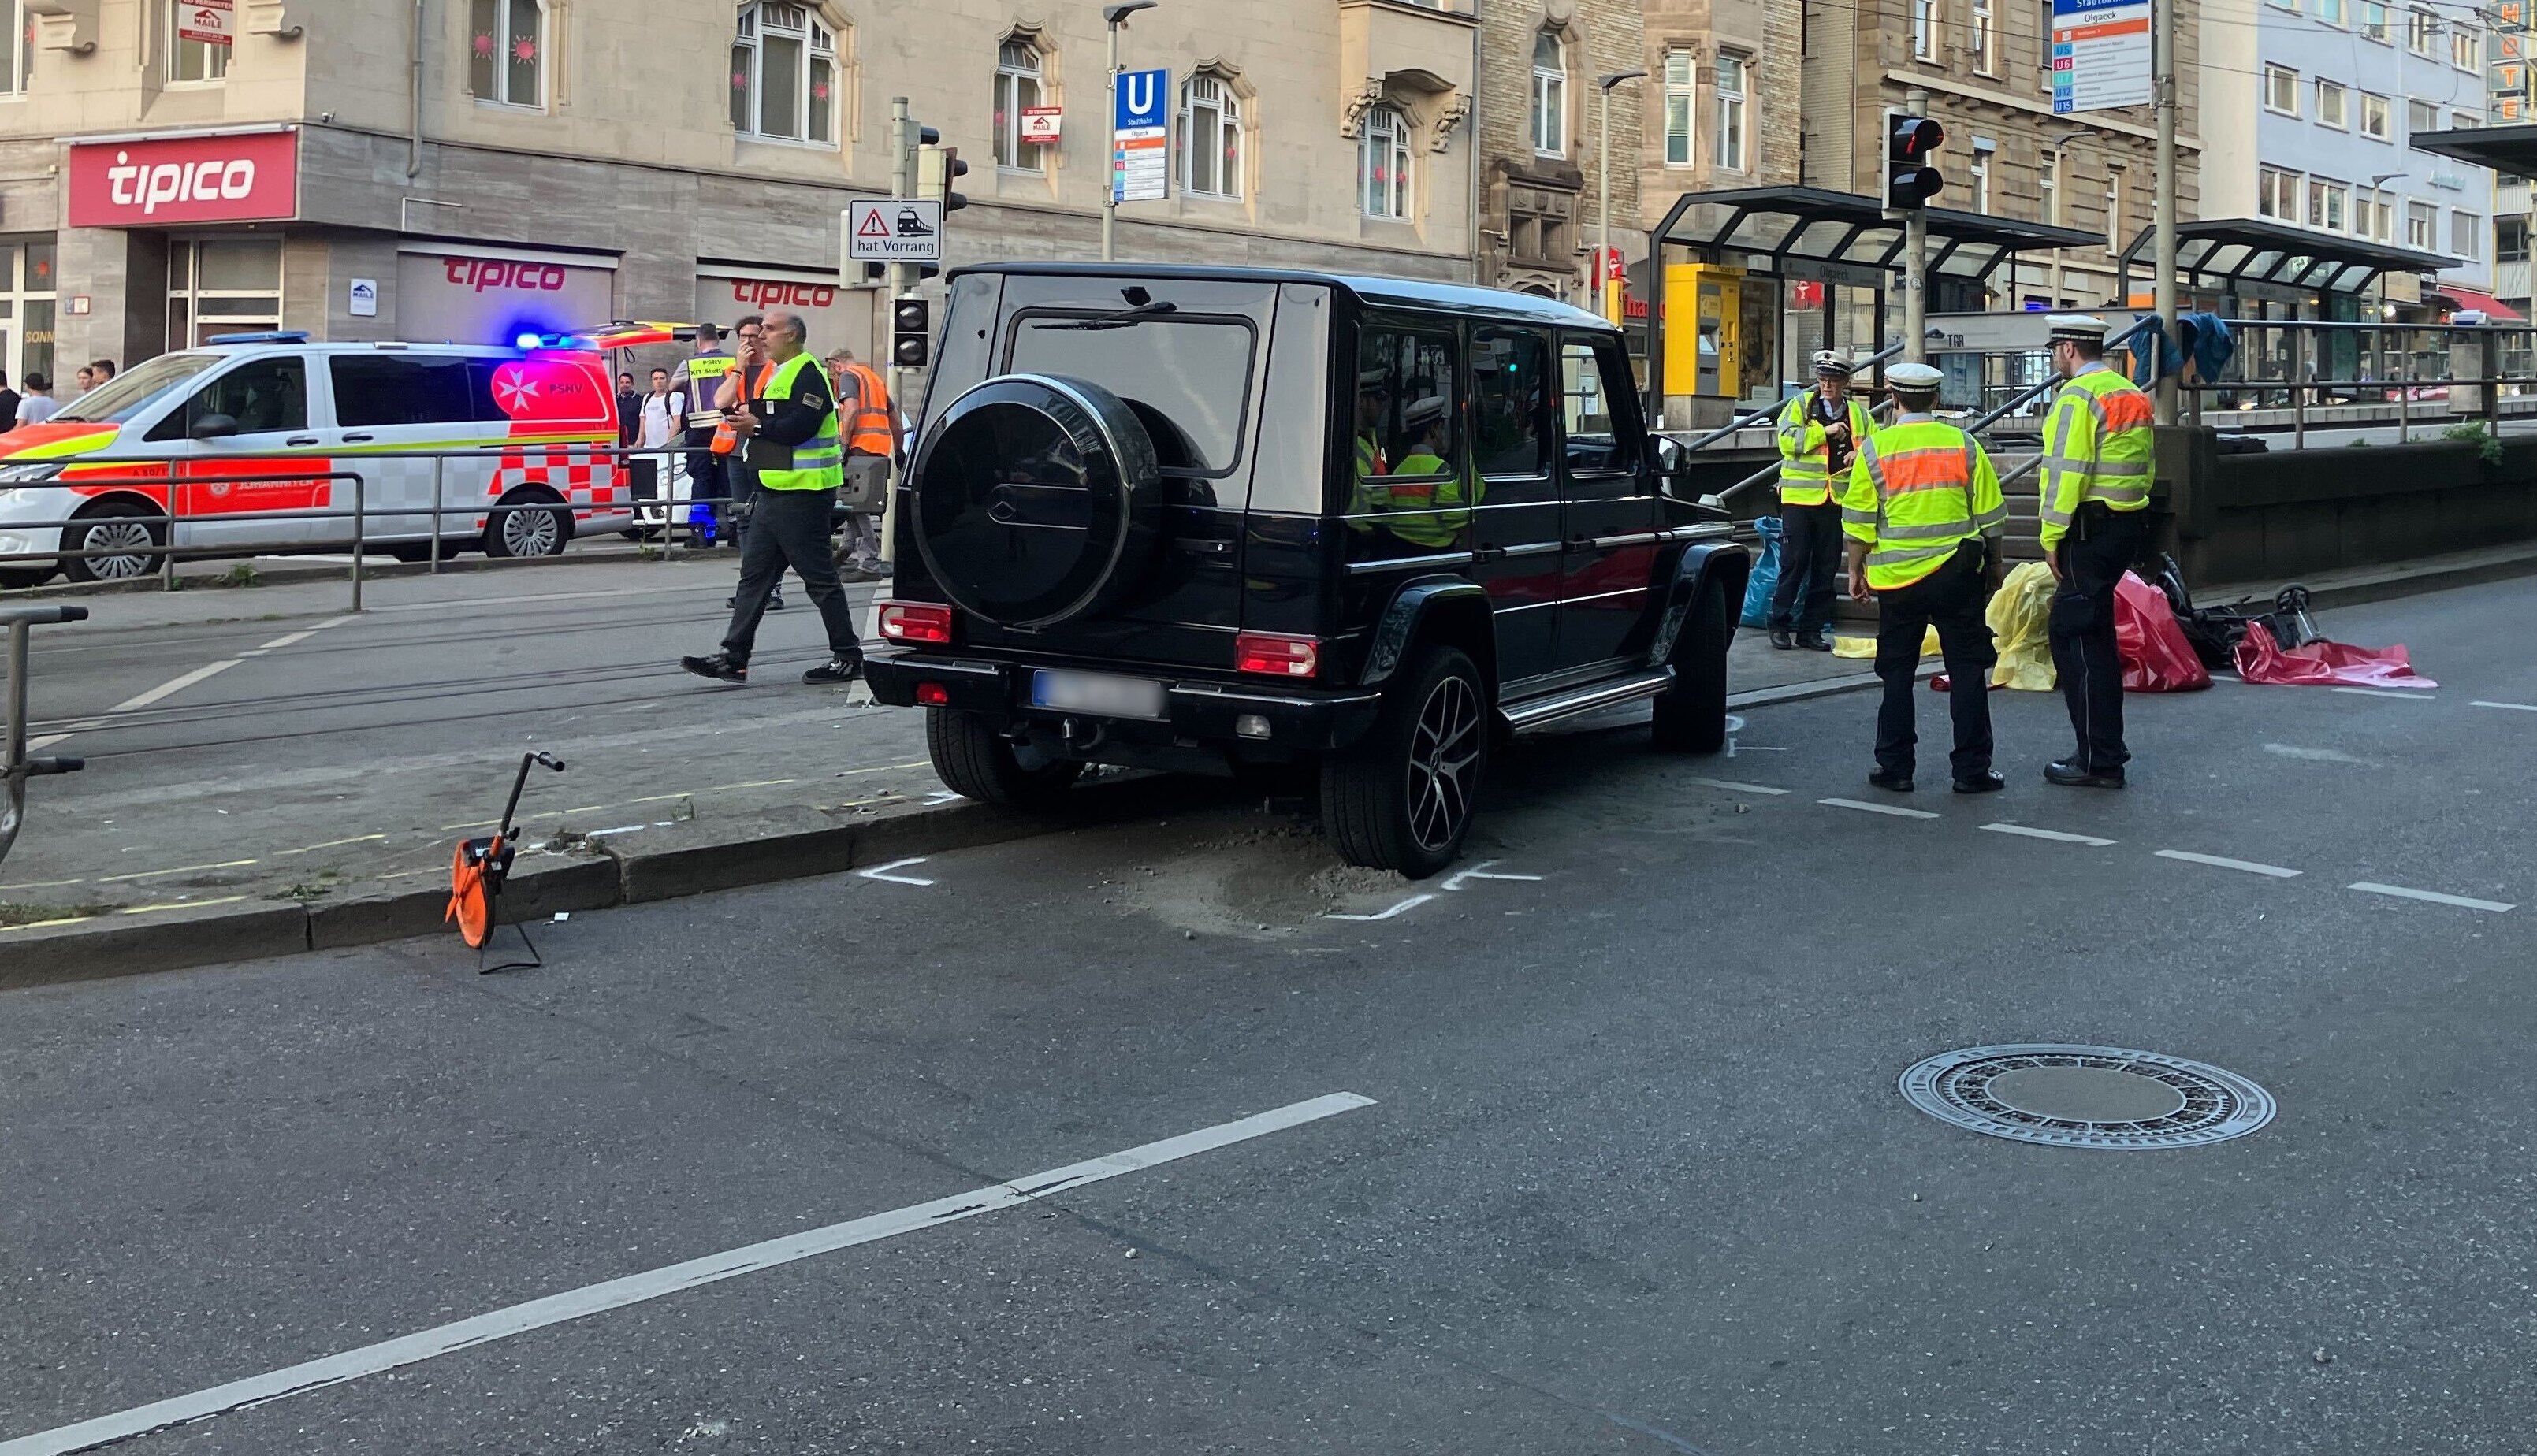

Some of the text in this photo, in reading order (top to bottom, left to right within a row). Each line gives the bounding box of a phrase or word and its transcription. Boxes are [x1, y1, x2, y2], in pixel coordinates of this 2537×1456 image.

[2084, 11, 2117, 24] Olgaeck
[2056, 43, 2070, 55] U5
[2056, 59, 2070, 69] U6
[2501, 3, 2519, 120] HOTE
[1128, 74, 1154, 115] U
[2055, 87, 2071, 98] U12
[2055, 101, 2072, 111] U15
[107, 150, 255, 214] tipico
[857, 240, 934, 255] hat Vorrang
[443, 257, 566, 293] tipico
[731, 279, 835, 310] tipico
